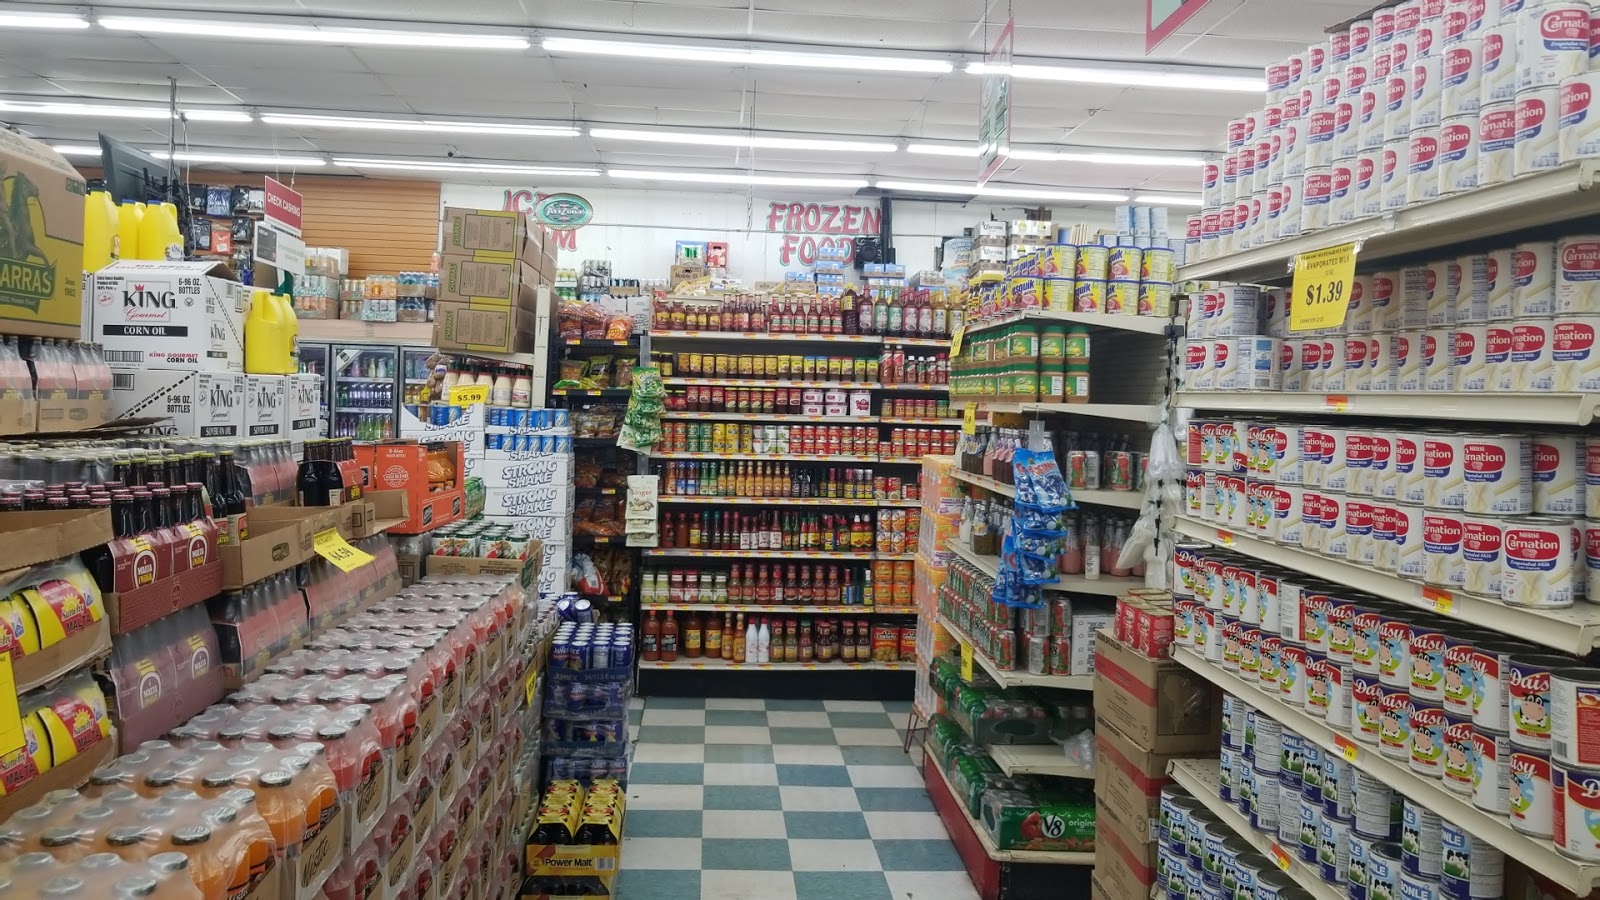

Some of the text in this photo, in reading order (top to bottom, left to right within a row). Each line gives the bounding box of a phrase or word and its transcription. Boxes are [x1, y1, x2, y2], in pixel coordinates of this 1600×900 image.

[1543, 15, 1590, 32] Carnatio
[1480, 119, 1515, 135] Carnatio
[267, 192, 301, 217] CHECK CASHING
[767, 202, 881, 233] FROZEN
[1307, 258, 1338, 270] EVAPORATED
[1563, 249, 1600, 264] Carnati
[0, 263, 51, 291] ARRAS
[179, 278, 202, 286] 6-96 OZ.
[64, 287, 76, 297] 1982
[1012, 280, 1035, 292] esquik
[1306, 280, 1343, 307] $1.39
[122, 290, 177, 309] KING
[123, 306, 167, 322] Gourmet
[123, 327, 167, 335] CORN OIL
[1513, 334, 1542, 344] rnation
[1487, 336, 1510, 345] nation
[167, 395, 181, 405] 6-96
[210, 389, 233, 407] KING
[257, 392, 276, 408] KING
[457, 394, 481, 402] $5.99
[167, 404, 191, 413] BOTTLES
[1347, 443, 1373, 451] rnation
[1397, 447, 1415, 455] ation
[1425, 449, 1451, 459] nation
[1535, 453, 1557, 462] ation
[502, 461, 557, 480] STRONG
[507, 472, 553, 488] SHAKE
[502, 488, 557, 507] STRONG
[507, 501, 552, 515] SHAKE
[1346, 510, 1373, 518] rnation
[513, 517, 556, 532] TRONG
[1463, 527, 1500, 542] arnation
[1506, 534, 1558, 550] Carnation
[1305, 597, 1327, 613] aisy
[1327, 601, 1353, 618] Dais
[66, 614, 92, 632] MALTA
[1354, 615, 1380, 632] aisy
[1380, 625, 1406, 641] aisy
[1305, 656, 1326, 672] Dai
[1510, 668, 1550, 691] Dais
[1443, 717, 1472, 739] Dais
[77, 728, 100, 748] MALTA
[6, 762, 35, 785] MALTA
[1510, 755, 1537, 779] aisy
[1042, 815, 1062, 838] V8
[1442, 830, 1462, 846] NLE
[545, 857, 593, 867] Power Malt
